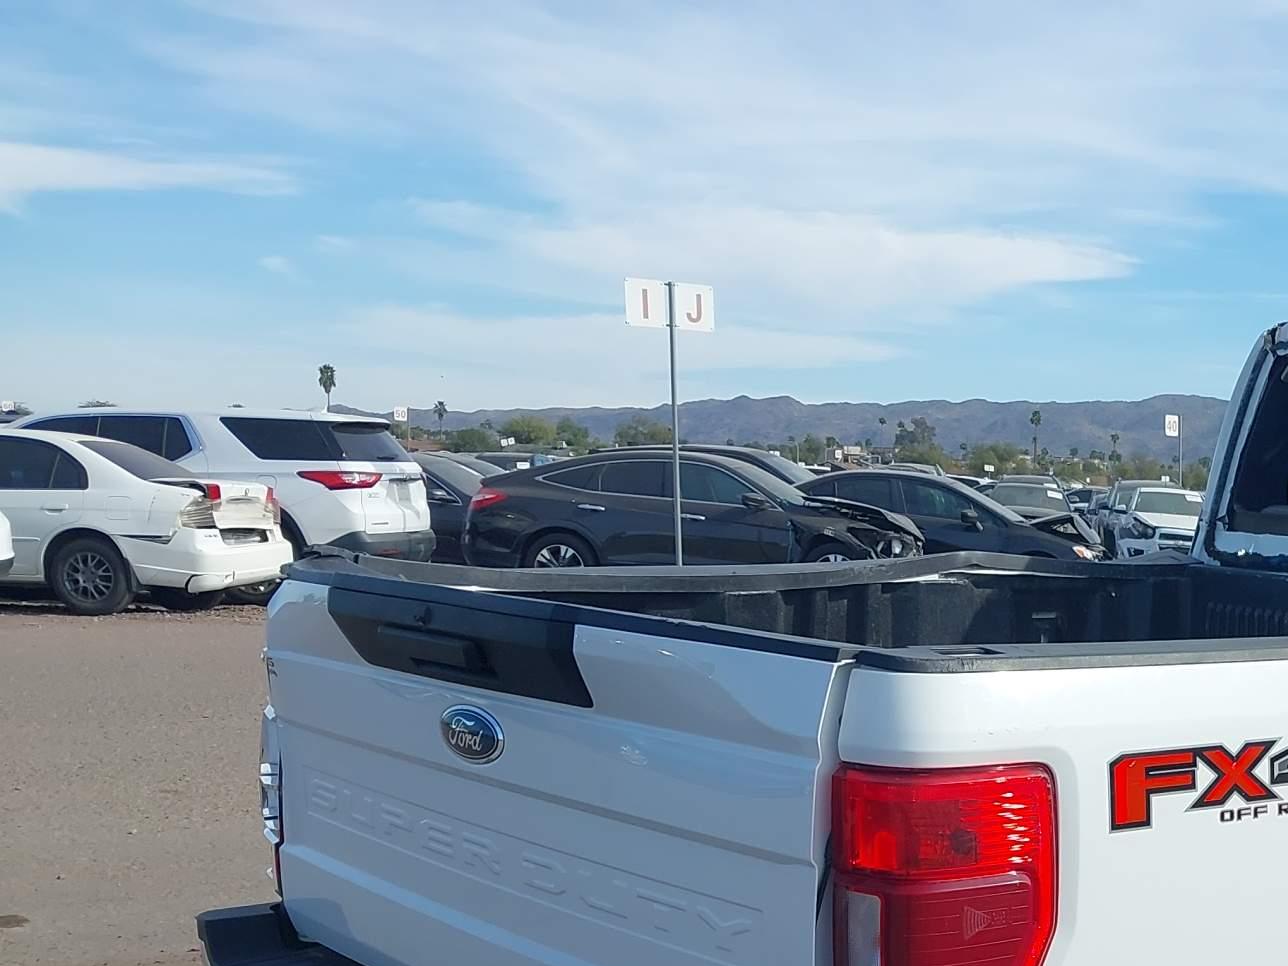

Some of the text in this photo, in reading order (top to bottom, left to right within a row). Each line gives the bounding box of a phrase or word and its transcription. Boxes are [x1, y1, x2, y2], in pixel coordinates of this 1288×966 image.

[641, 288, 649, 320] I
[685, 293, 703, 324] J
[1167, 420, 1177, 432] 40
[448, 716, 483, 751] Ford
[309, 777, 502, 876] SUPER
[1219, 804, 1269, 824] OFF
